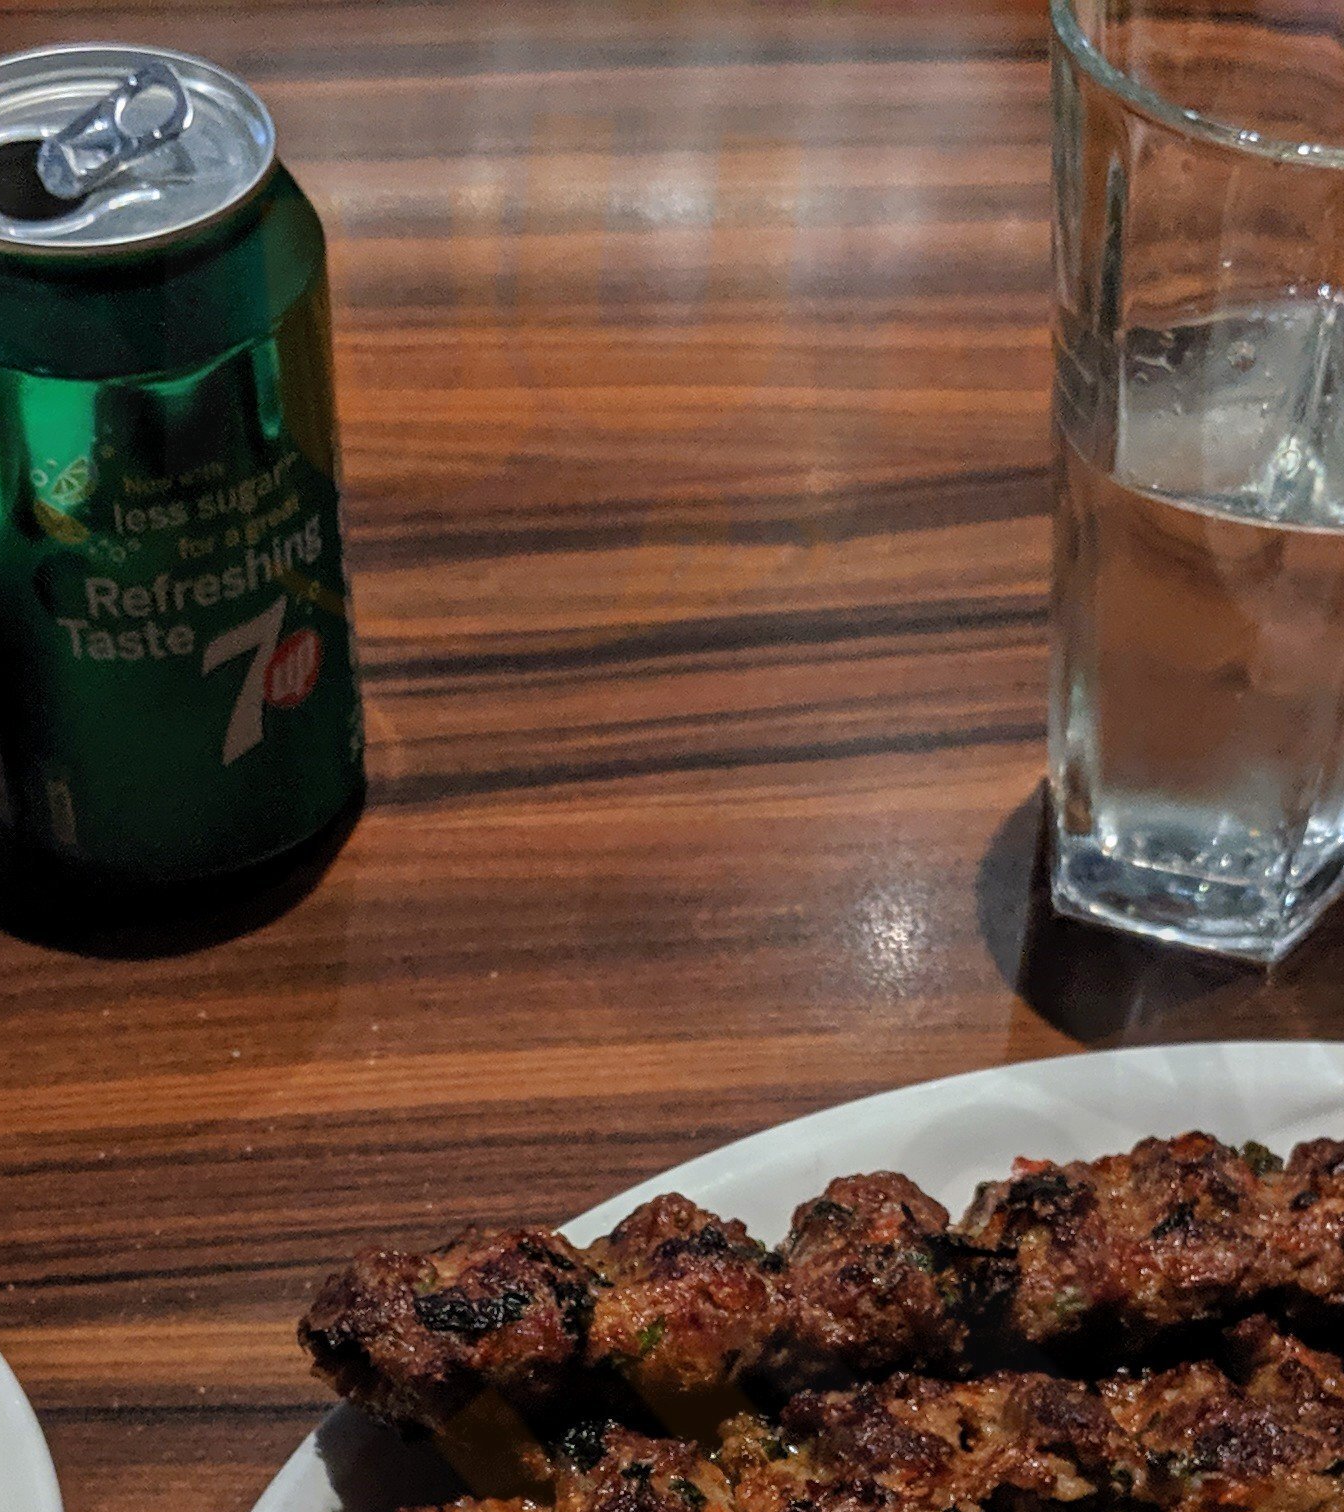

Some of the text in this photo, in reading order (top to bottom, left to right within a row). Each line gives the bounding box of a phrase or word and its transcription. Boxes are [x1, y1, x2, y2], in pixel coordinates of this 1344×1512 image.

[113, 498, 190, 534] less
[178, 536, 214, 560] for
[225, 528, 240, 547] a
[86, 514, 323, 618] Refreshing
[58, 615, 195, 661] Taste
